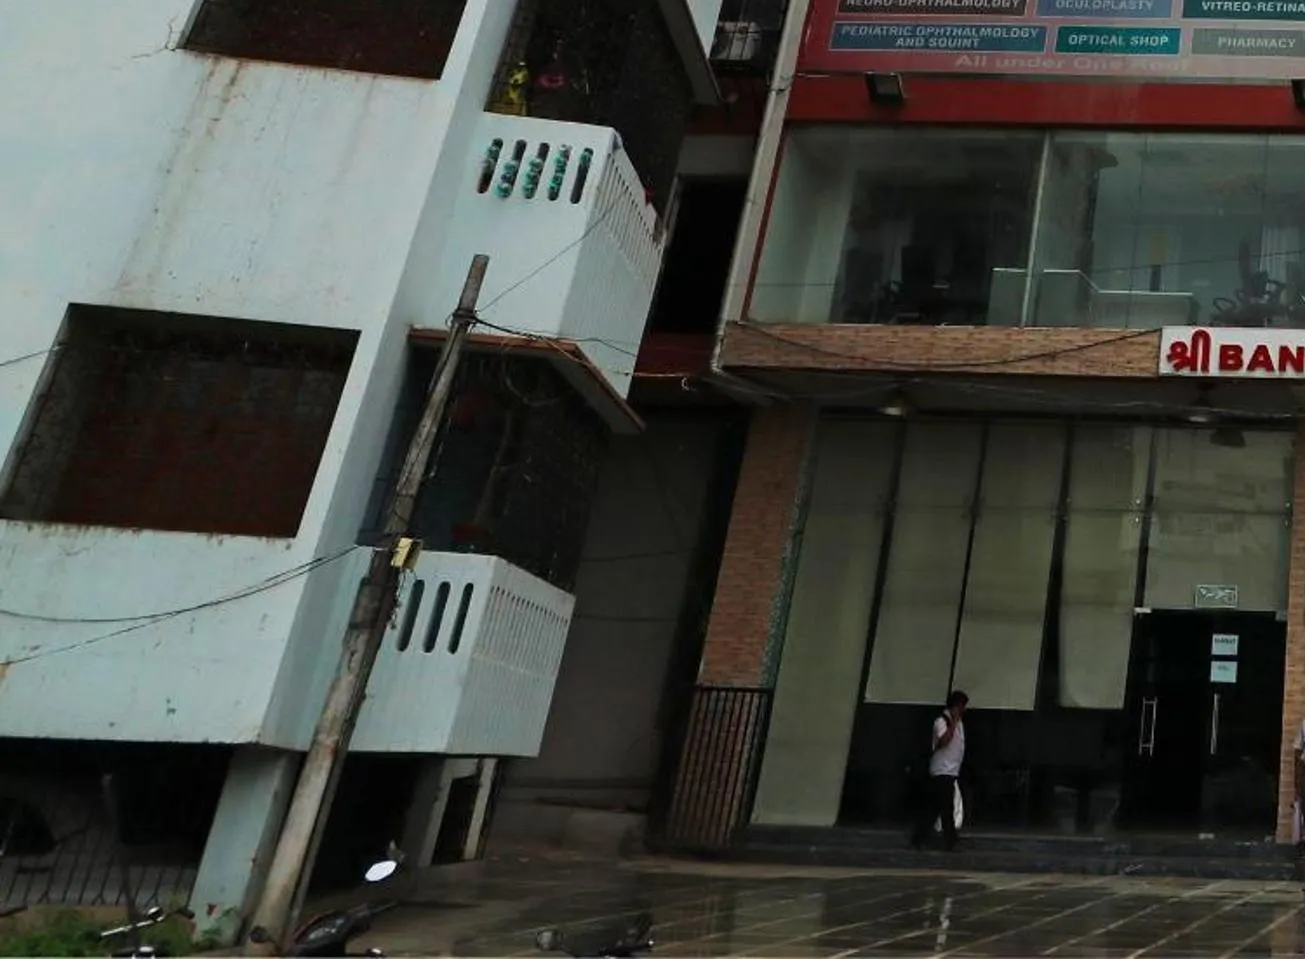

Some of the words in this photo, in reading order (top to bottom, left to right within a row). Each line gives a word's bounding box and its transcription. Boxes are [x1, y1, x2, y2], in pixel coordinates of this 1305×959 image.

[1055, 0, 1154, 10] OCULOPLASTY
[841, 25, 913, 36] PEDIATRIC
[916, 25, 1040, 38] OPHTHALMOLOGY
[895, 38, 925, 48] AND
[928, 38, 980, 49] SQUINT
[1068, 34, 1125, 46] OPTICAL
[1131, 35, 1169, 47] SHOP
[1218, 36, 1297, 49] PHARMACY
[954, 55, 986, 68] All
[995, 56, 1065, 69] under
[1167, 328, 1211, 373] श्री
